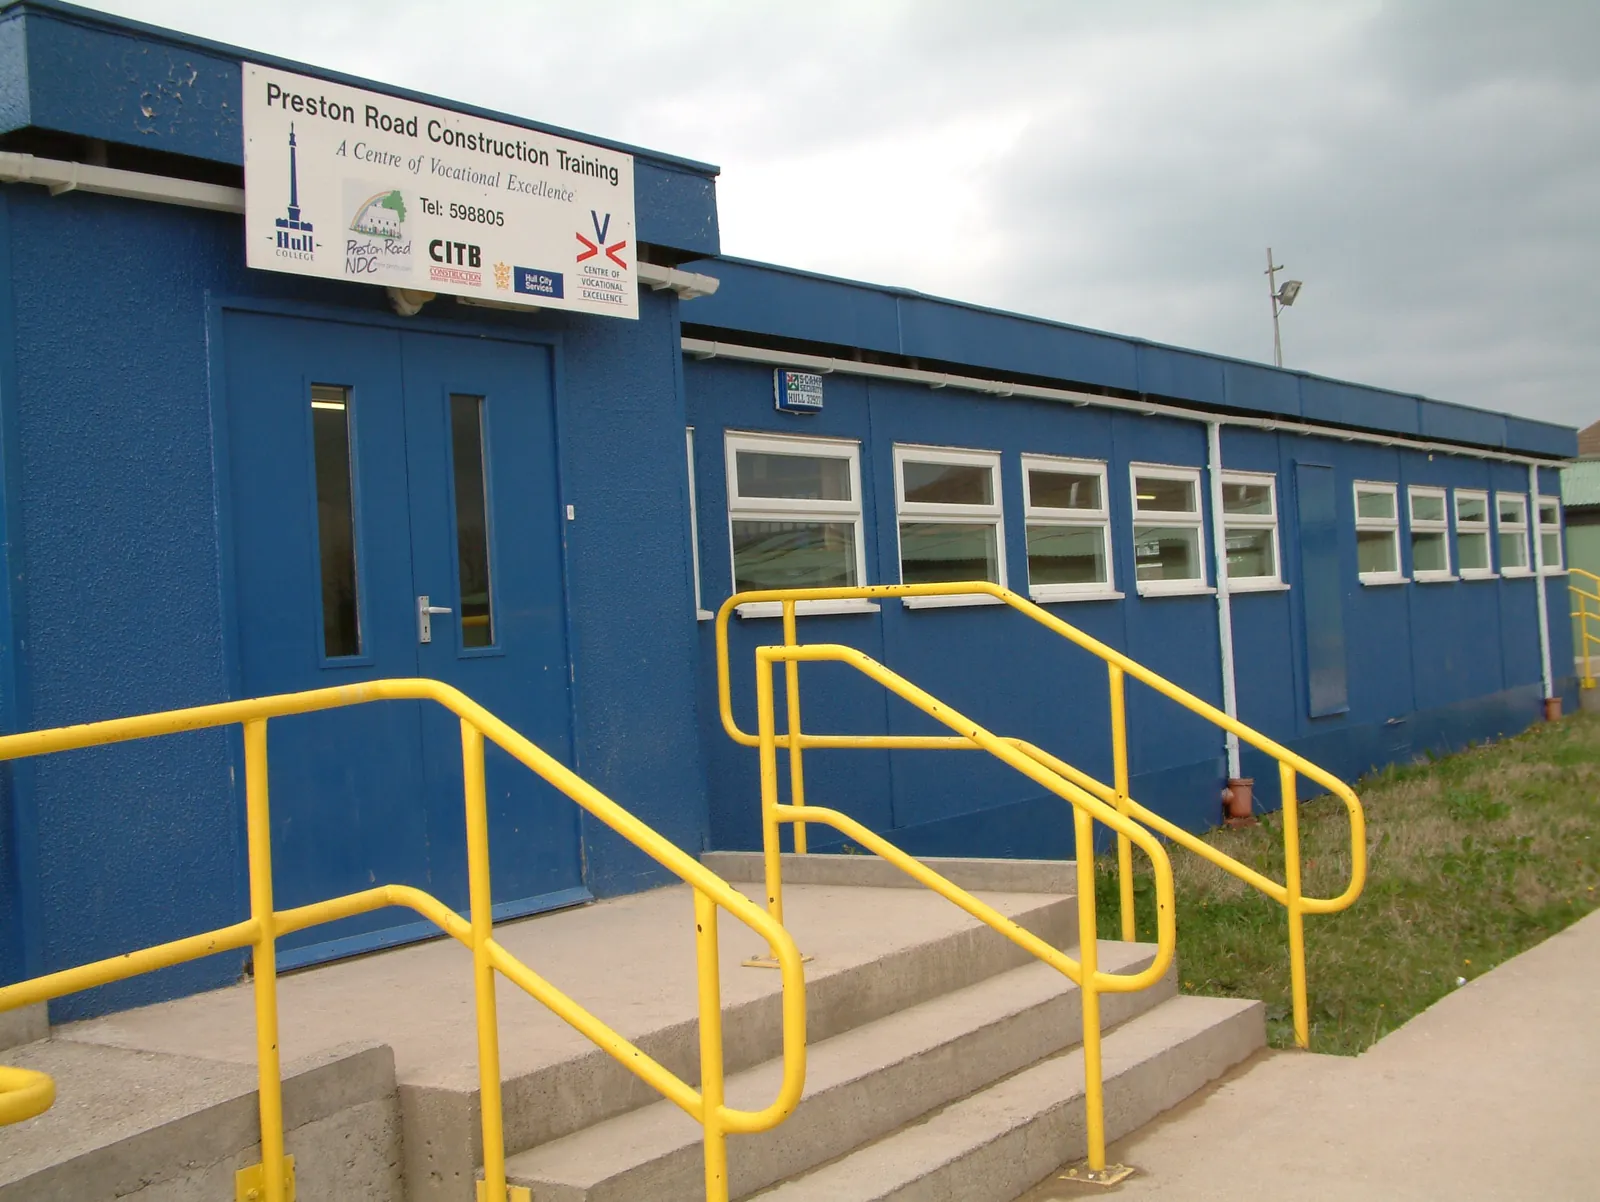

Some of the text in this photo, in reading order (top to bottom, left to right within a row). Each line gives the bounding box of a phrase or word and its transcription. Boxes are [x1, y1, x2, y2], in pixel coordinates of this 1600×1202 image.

[266, 82, 619, 186] Preston Road Construction Training
[336, 140, 575, 203] A Centre of Vocational Excellence
[420, 197, 505, 227] Tel: 598805
[276, 230, 314, 253] Hull
[346, 238, 412, 256] Preston Road
[275, 249, 315, 262] COLLEGE
[428, 239, 482, 268] CITB
[345, 256, 378, 274] NDC
[584, 265, 620, 278] CENTRE OF
[429, 267, 482, 281] CONSTRUCTION
[525, 273, 553, 286] Hull City
[525, 281, 554, 293] Services
[581, 278, 624, 291] VOCATIONAL
[582, 290, 623, 303] EXCELLENCE
[788, 392, 805, 403] HULL
